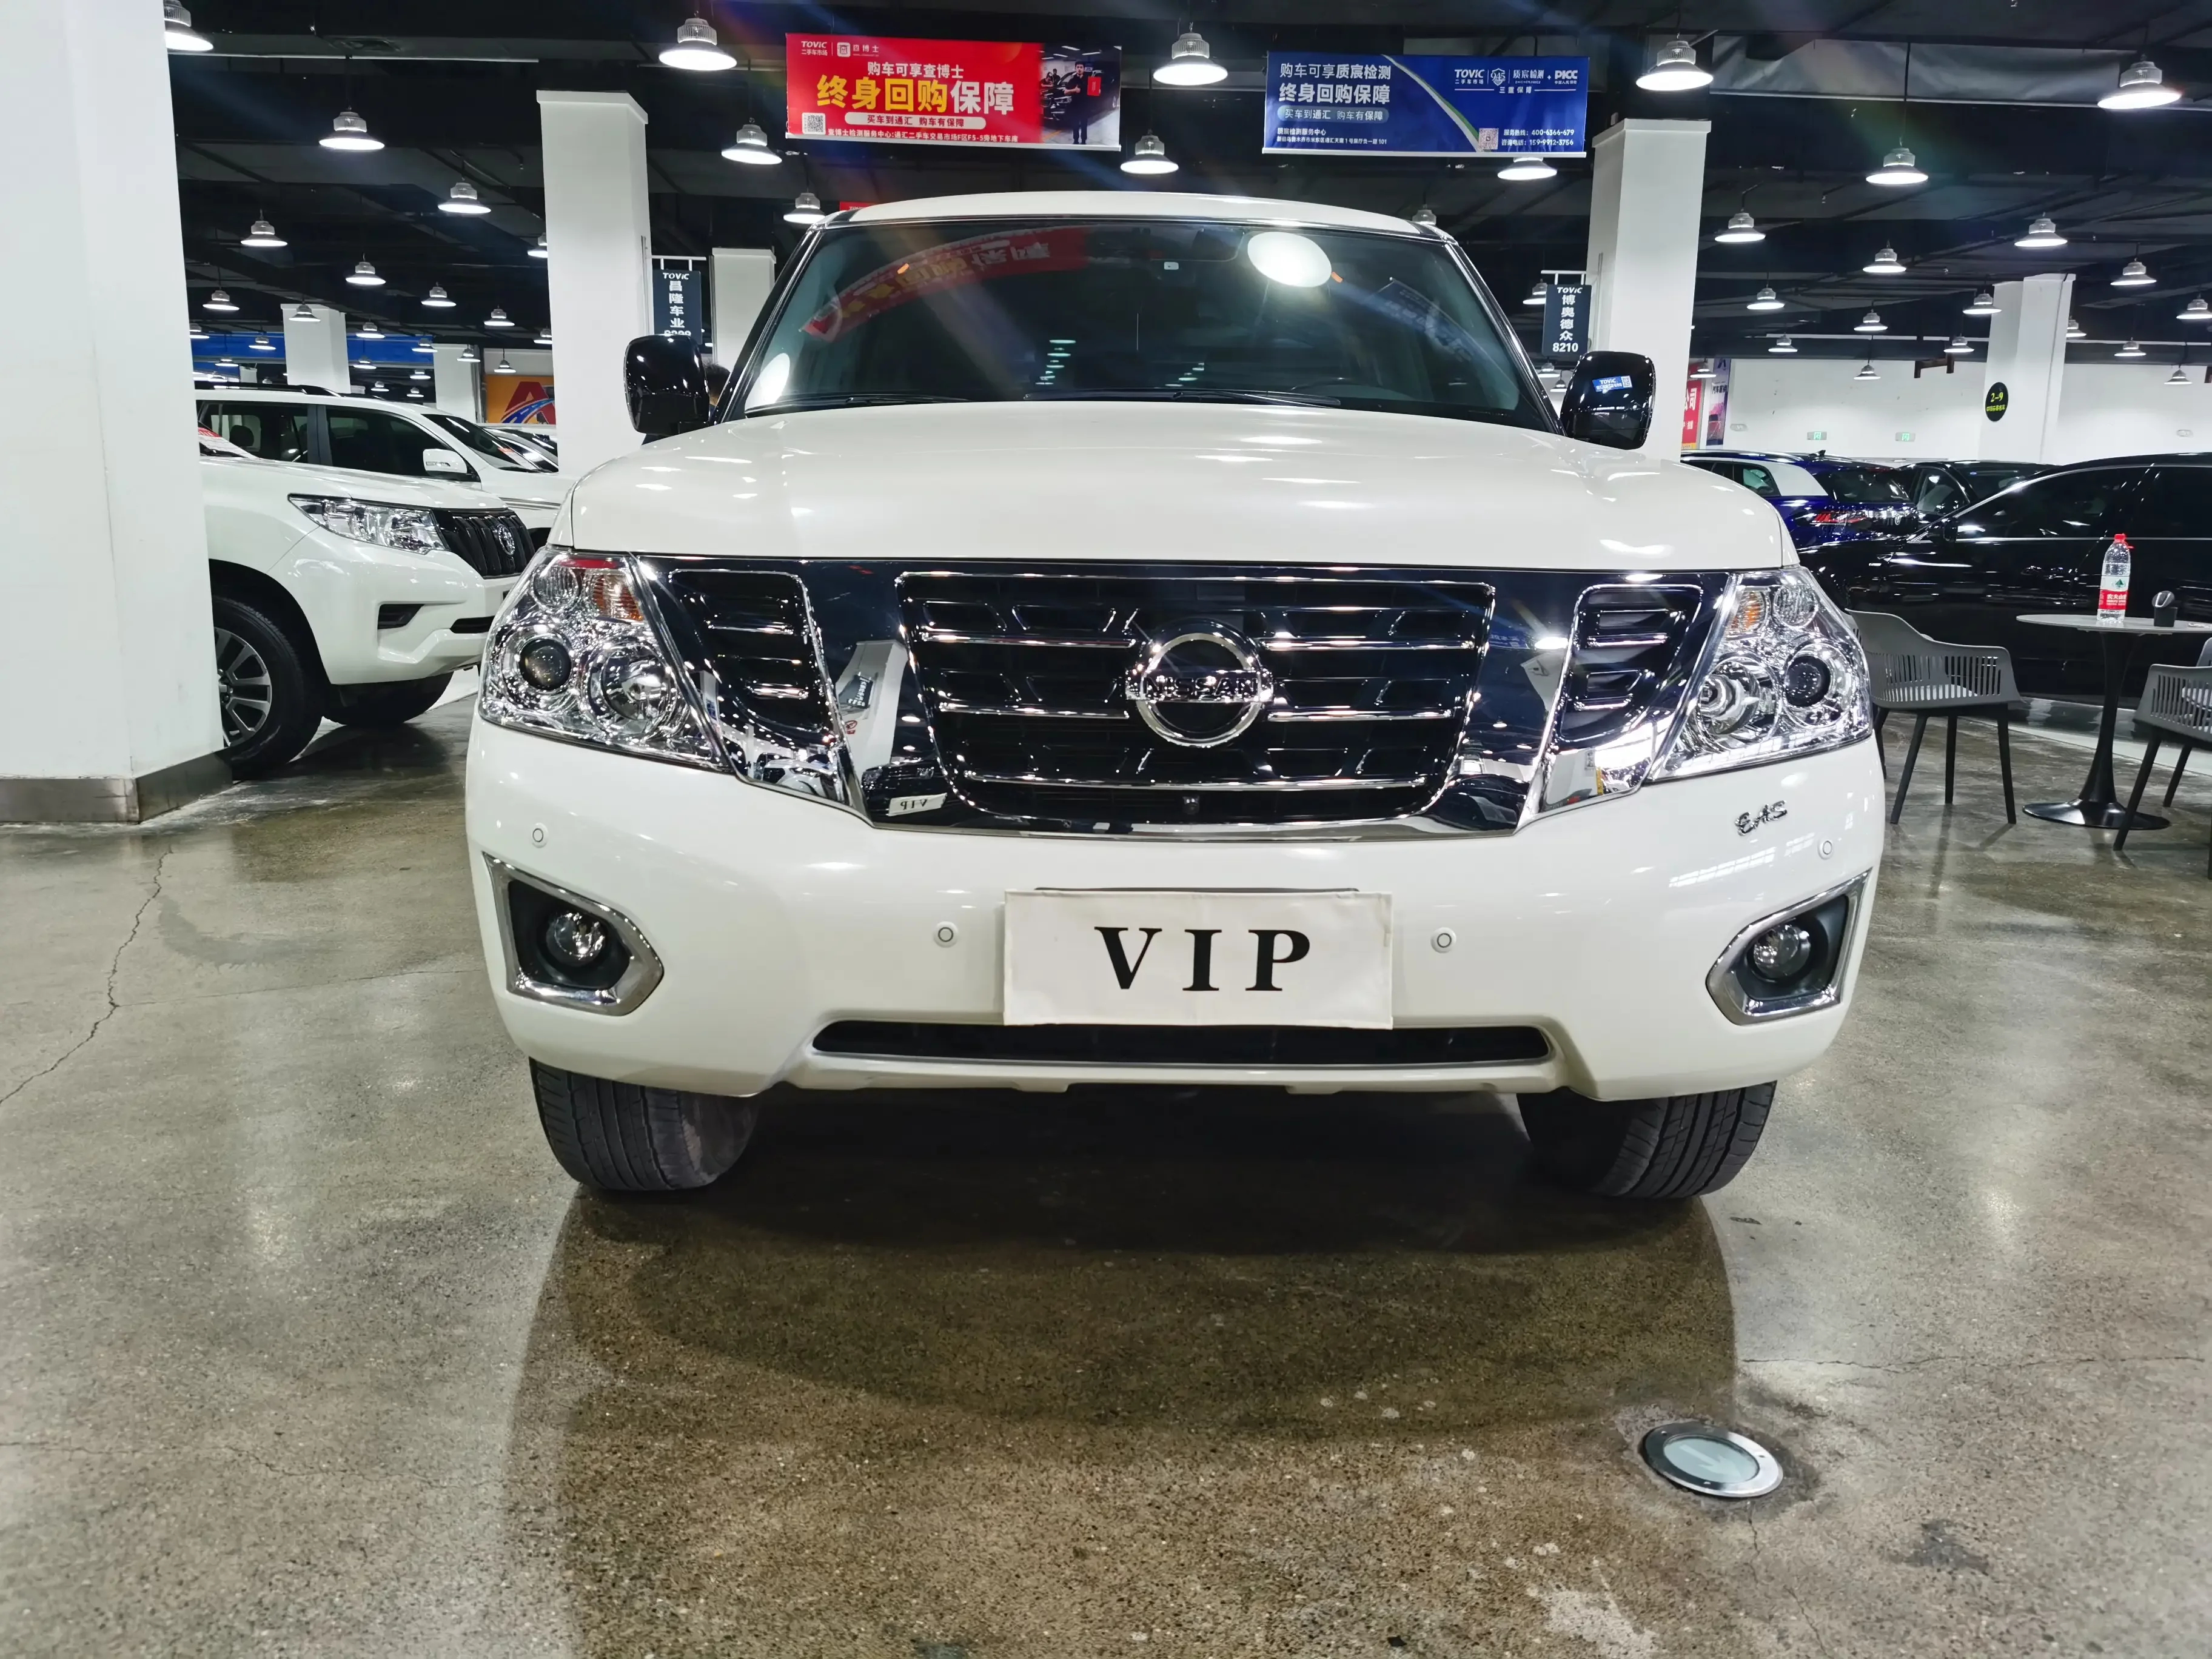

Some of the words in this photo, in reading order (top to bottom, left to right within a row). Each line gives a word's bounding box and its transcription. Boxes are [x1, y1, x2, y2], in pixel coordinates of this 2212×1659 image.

[868, 61, 964, 79] 购车可享查博士
[1279, 62, 1392, 80] 购车可享质宸检测
[1454, 69, 1485, 78] TOVIC
[1513, 69, 1544, 79] 质宸检测
[1554, 70, 1578, 79] PICC
[817, 74, 1014, 115] 终身回购保障
[1279, 82, 1390, 105] 终身回购保障
[866, 115, 913, 126] 买车到通汇
[919, 116, 965, 127] 购车有保障
[1284, 109, 1331, 119] 买车到通汇
[1336, 110, 1383, 121] 购车有保障
[669, 280, 685, 328] 昌隆车业
[1559, 294, 1576, 341] 博奥德众
[1552, 342, 1578, 352] 8210
[1144, 676, 1258, 698] NISSAN
[1094, 926, 1310, 991] VIP
